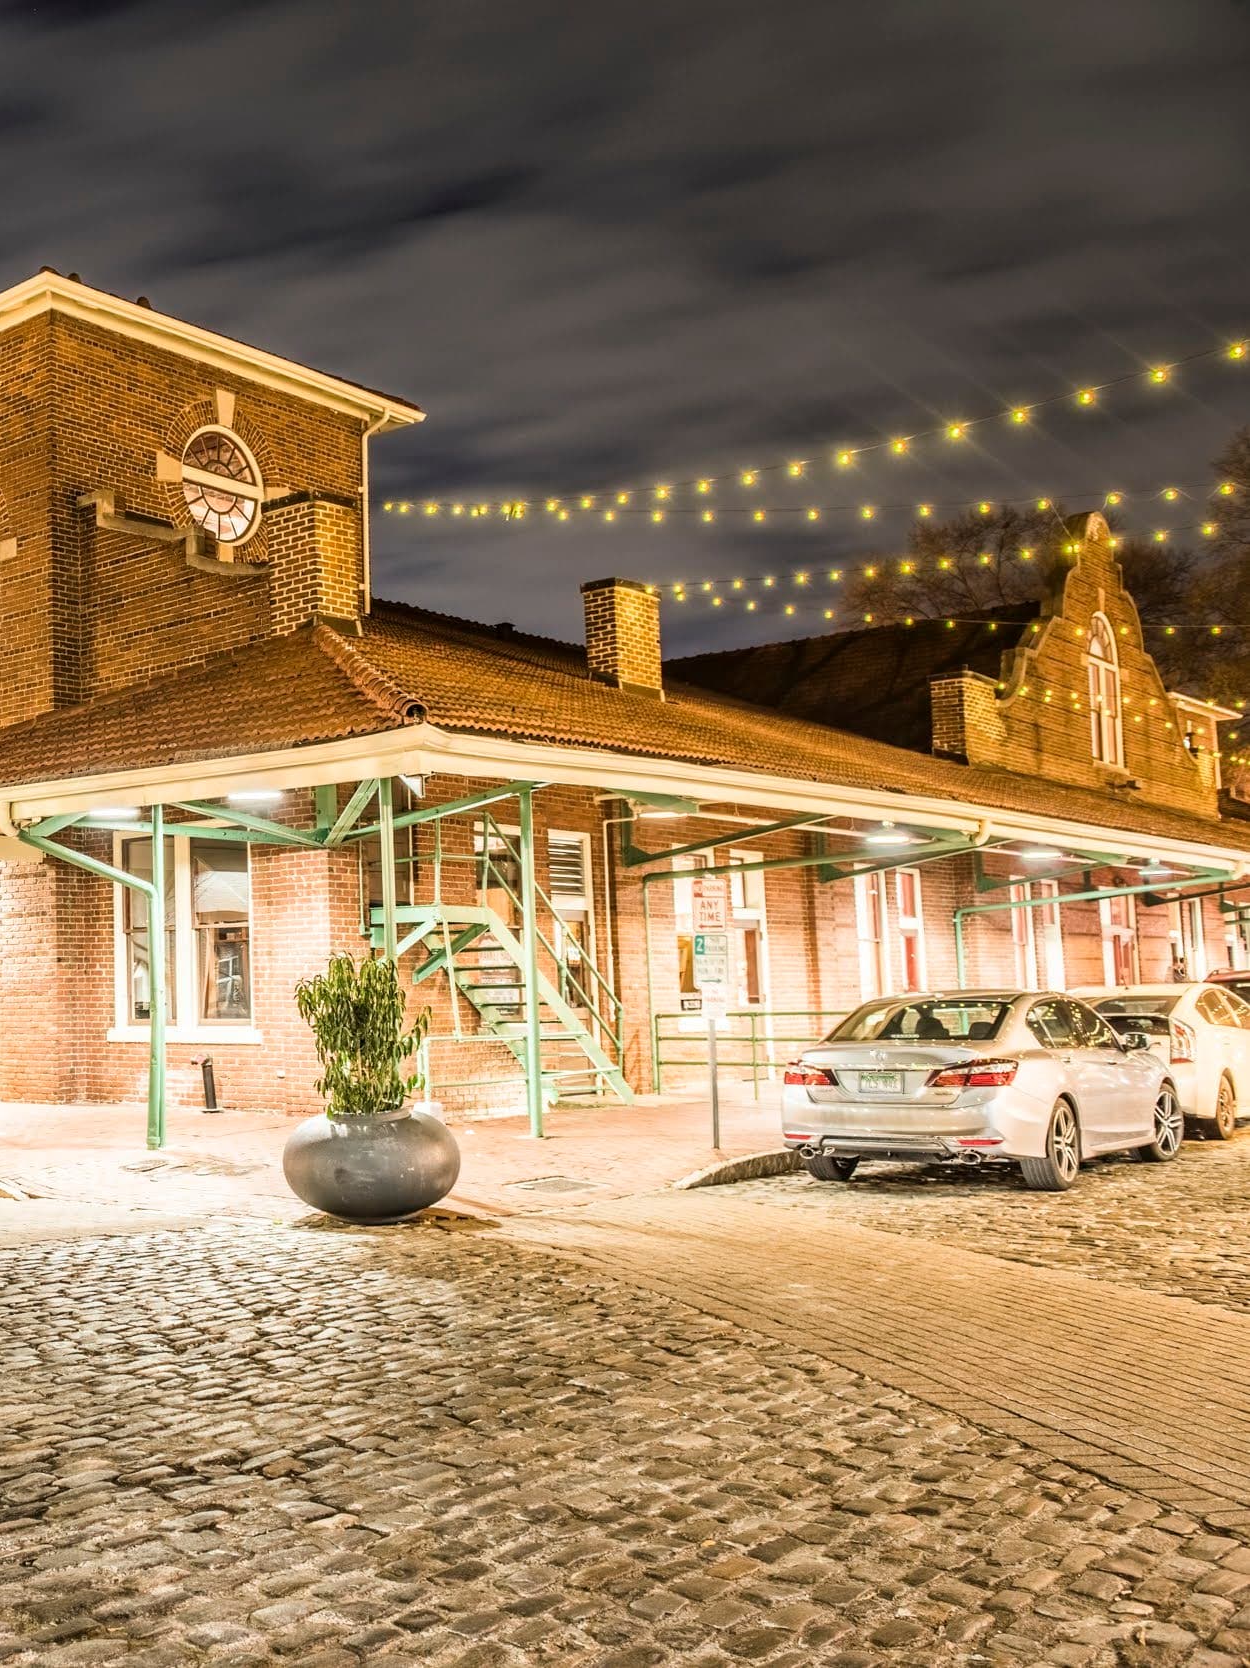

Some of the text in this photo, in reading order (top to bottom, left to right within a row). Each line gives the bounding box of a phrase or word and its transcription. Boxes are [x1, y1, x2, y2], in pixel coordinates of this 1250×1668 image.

[700, 900, 719, 910] ANY
[699, 912, 721, 922] TIME
[696, 938, 703, 952] 2
